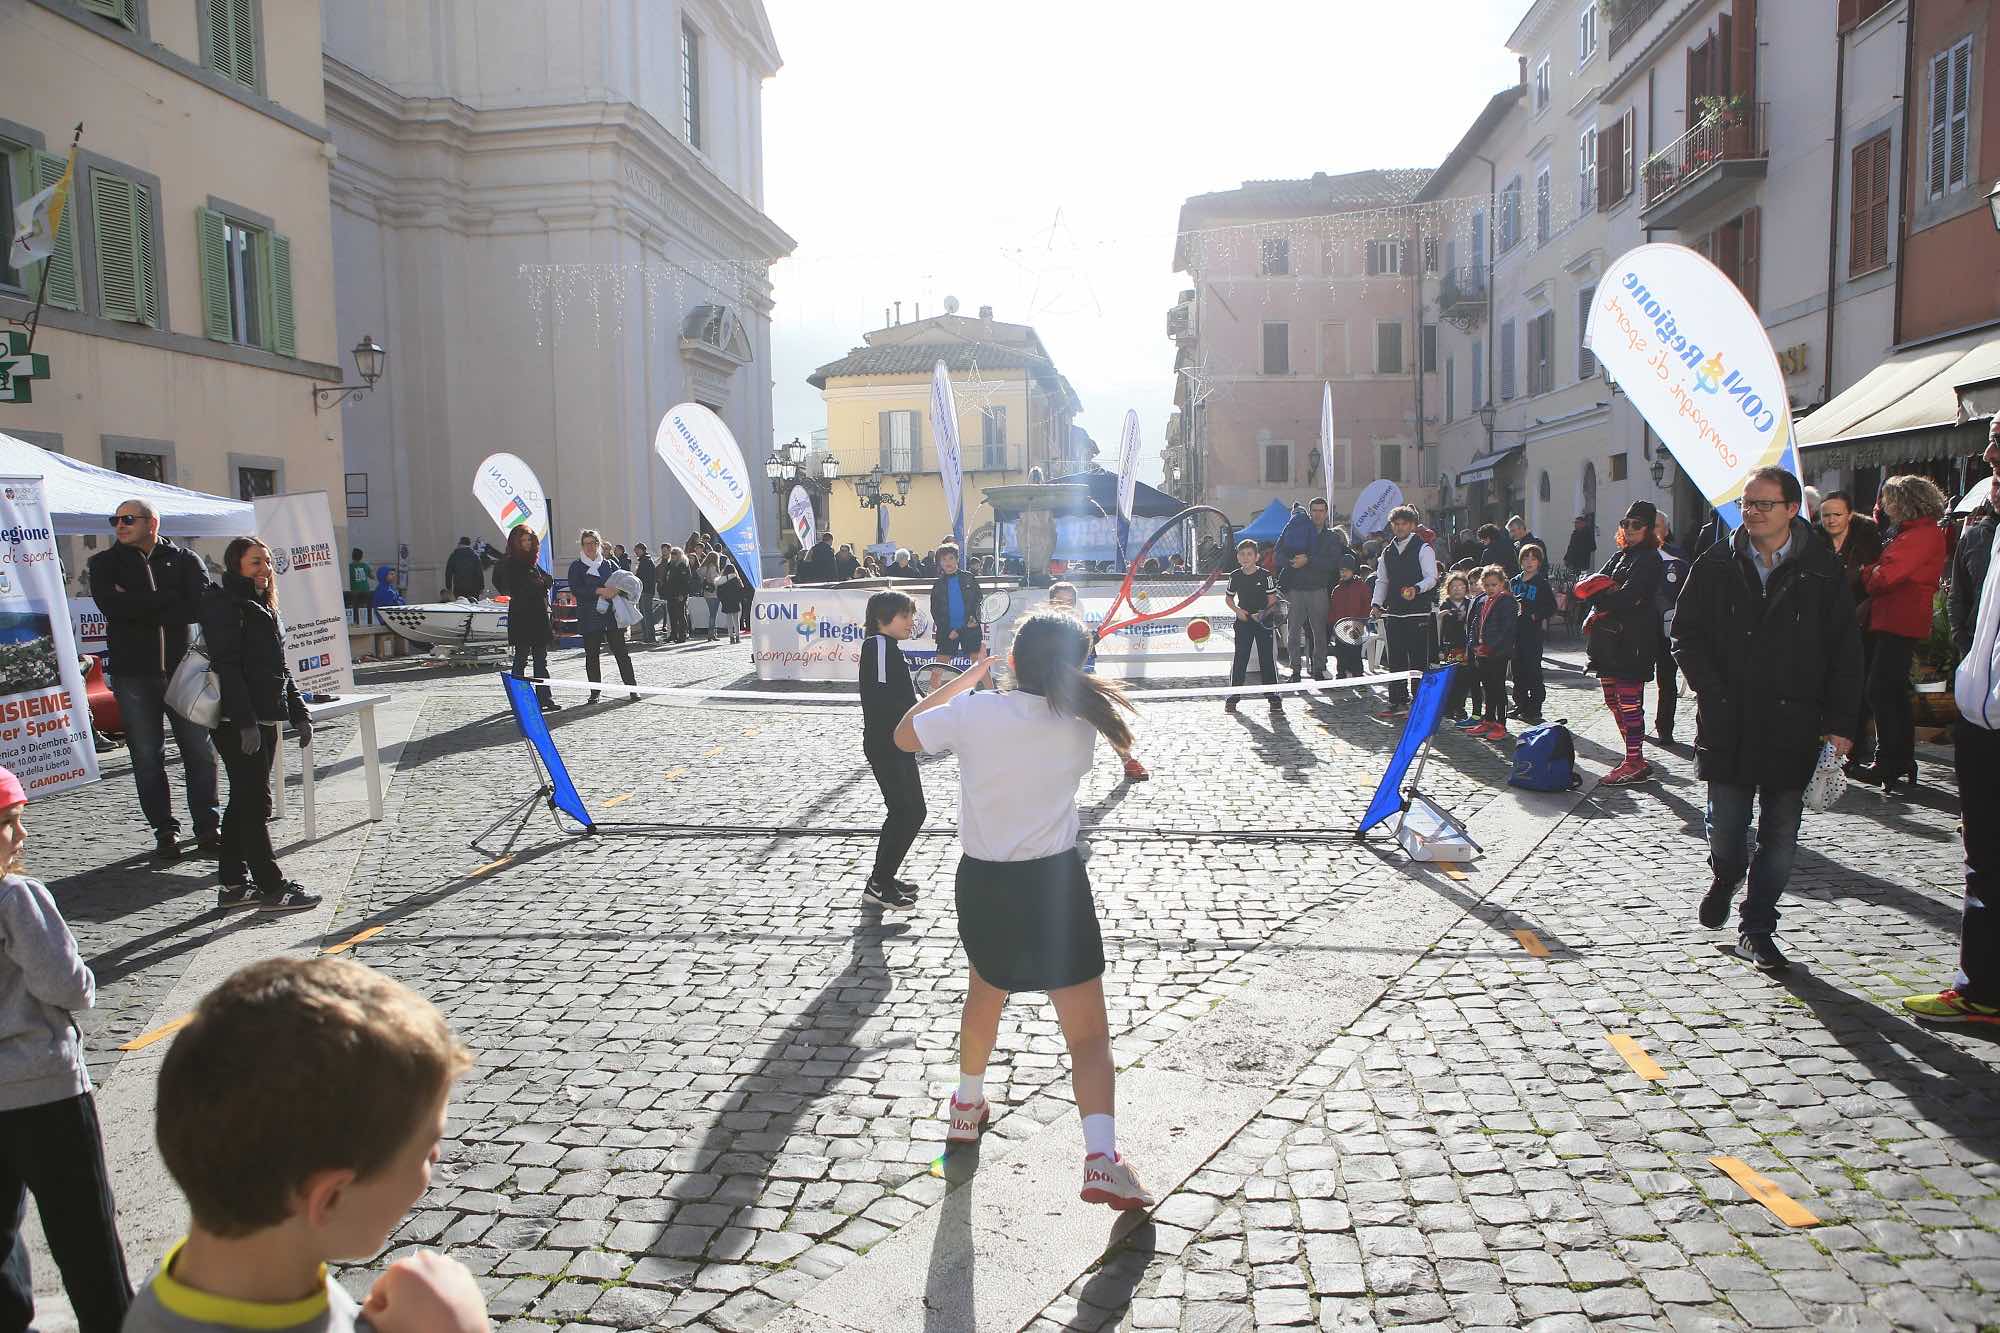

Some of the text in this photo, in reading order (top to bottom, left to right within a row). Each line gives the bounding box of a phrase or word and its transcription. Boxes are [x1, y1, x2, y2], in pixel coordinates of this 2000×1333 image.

[3, 547, 54, 568] di sport
[291, 543, 330, 556] RADIO ROMA
[292, 550, 332, 565] CAPITALE
[754, 602, 798, 620] CONI
[756, 646, 823, 668] compagni
[828, 643, 846, 662] di
[26, 713, 71, 738] Sport
[21, 745, 26, 755] 9
[29, 736, 68, 752] Dicembre
[70, 730, 88, 743] 2018
[18, 755, 37, 766] 10.00
[38, 752, 52, 762] alle
[53, 746, 72, 757] 18.00
[26, 765, 44, 776] della
[30, 768, 86, 789] GANDOLFO
